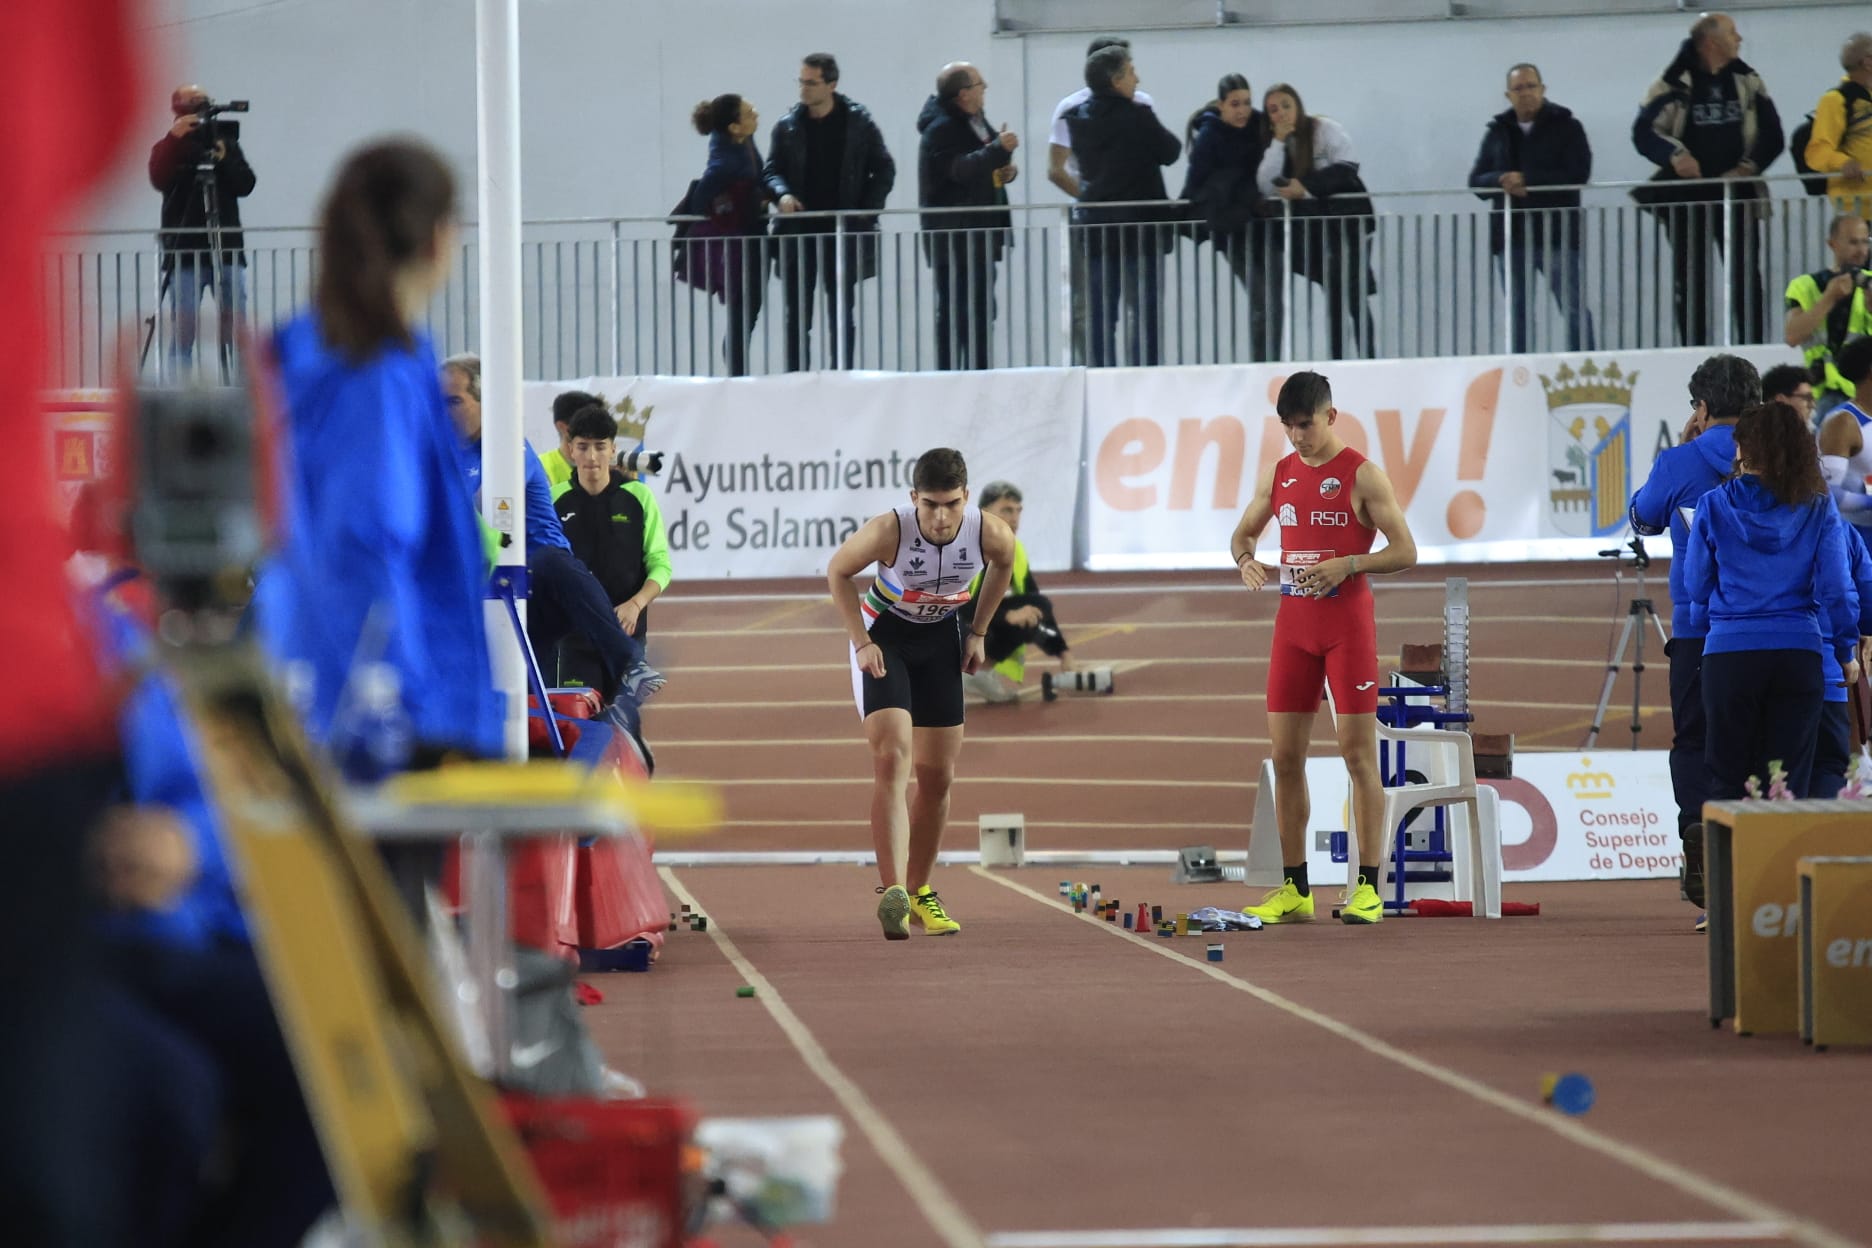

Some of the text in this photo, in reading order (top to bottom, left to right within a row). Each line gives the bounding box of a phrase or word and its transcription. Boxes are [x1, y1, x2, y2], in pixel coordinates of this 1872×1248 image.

[1095, 368, 1504, 542] enjy!
[665, 449, 915, 503] Ayuntamiento
[668, 507, 869, 551] de Salama
[1310, 511, 1348, 527] RSQ
[917, 604, 951, 616] 196
[1580, 808, 1658, 828] Consejo
[1586, 830, 1668, 850] Superior
[1590, 854, 1613, 869] de
